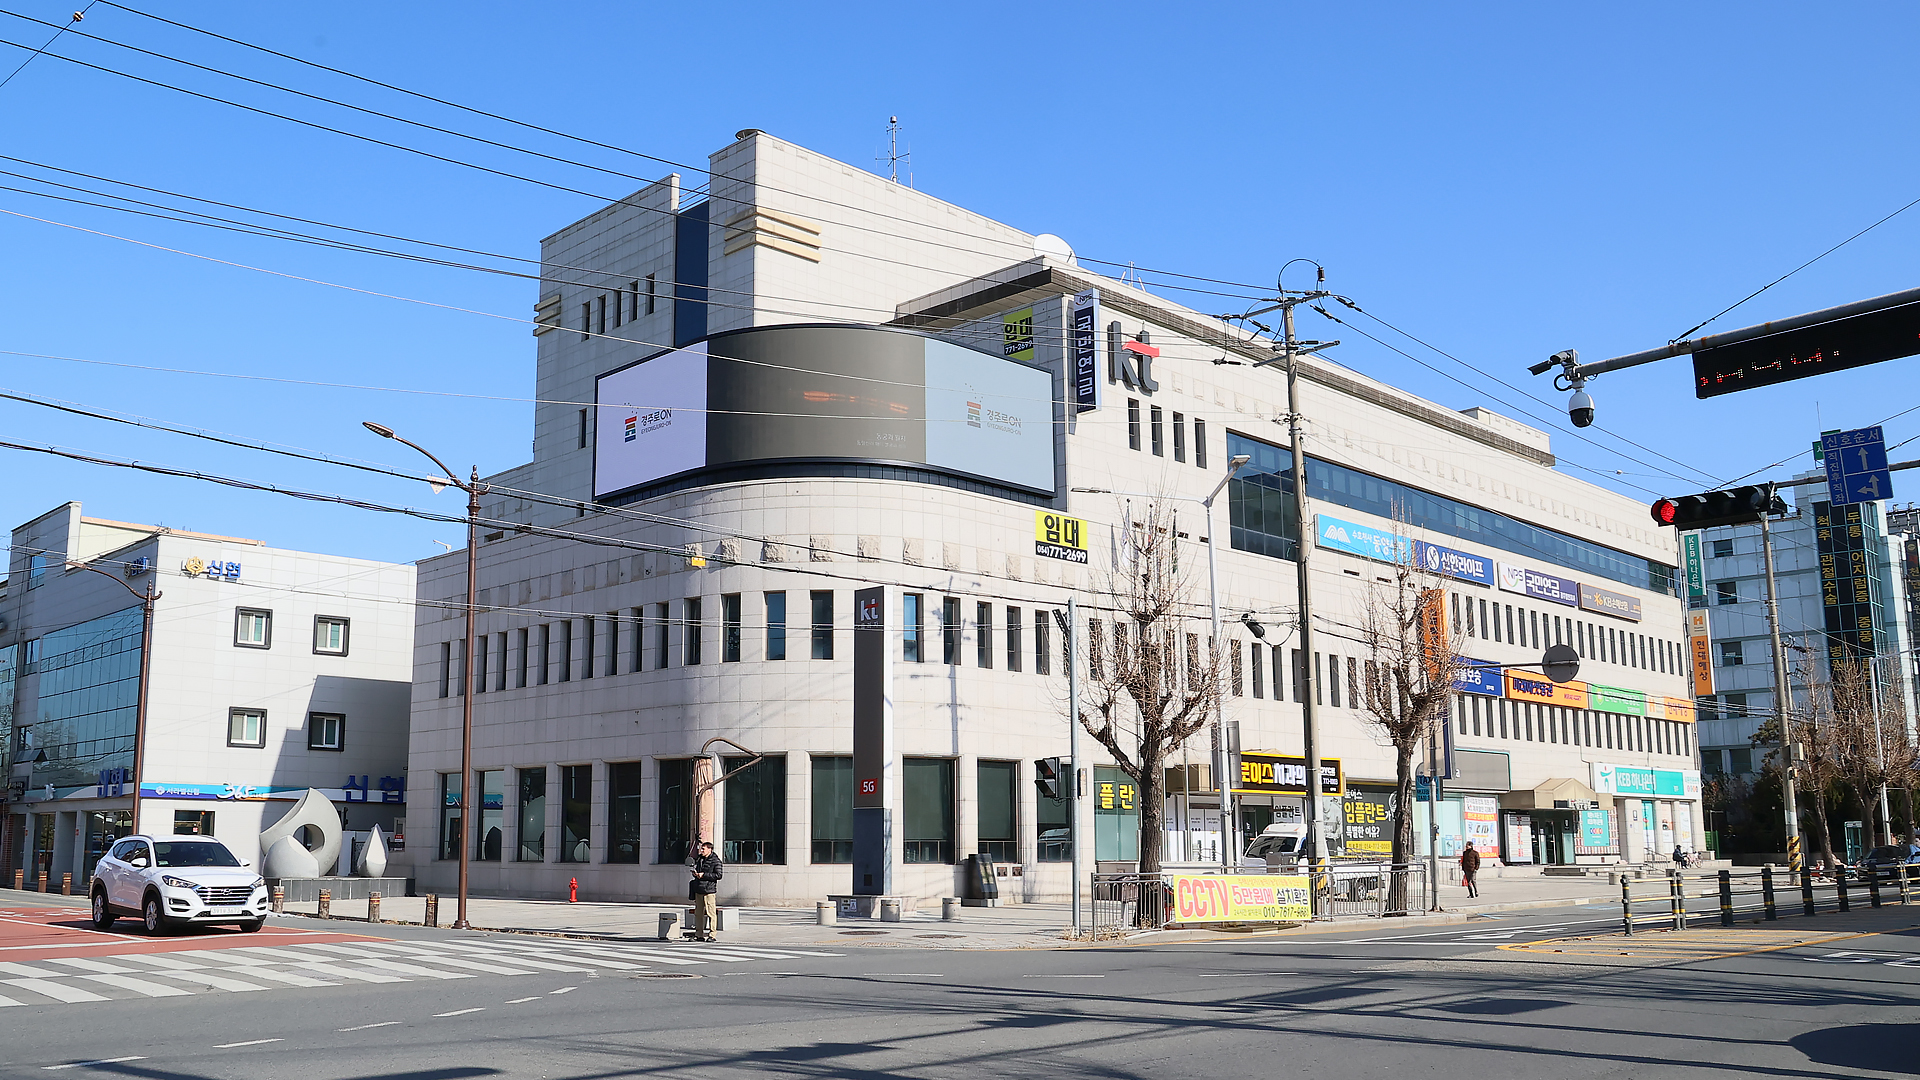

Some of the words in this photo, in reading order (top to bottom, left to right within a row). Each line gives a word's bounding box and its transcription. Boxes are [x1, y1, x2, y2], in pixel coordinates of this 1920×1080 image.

[1004, 316, 1032, 341] 임대
[1077, 315, 1093, 397] 국민연금
[1108, 320, 1160, 397] kt
[641, 407, 672, 426] 경주로ON
[986, 409, 1022, 428] 경주로ON
[1826, 428, 1880, 448] 신호순서
[1044, 515, 1080, 548] 임대
[1817, 515, 1832, 541] 척추
[1847, 511, 1863, 538] 두통
[1688, 536, 1696, 558] KEB
[207, 560, 241, 578] 신협
[1441, 552, 1485, 578] 신한라이프
[1507, 567, 1524, 581] NPS
[1851, 551, 1869, 603] 어지럼증
[1526, 573, 1560, 599] 국민연금
[1820, 554, 1838, 606] 관절수술
[860, 599, 879, 621] kt
[1858, 616, 1873, 643] 중풍
[862, 781, 875, 793] 5G
[1241, 762, 1307, 787] 로이스치과의
[1617, 772, 1631, 788] KEB
[166, 786, 200, 796] 서라벌신협
[216, 780, 257, 799] 365
[341, 775, 405, 803] 신협
[1345, 825, 1365, 839] 특별한
[1365, 826, 1381, 838] 이유?
[1178, 879, 1229, 918] CCTV
[1231, 885, 1275, 905] 5만원에
[1276, 887, 1309, 906] 설치확정
